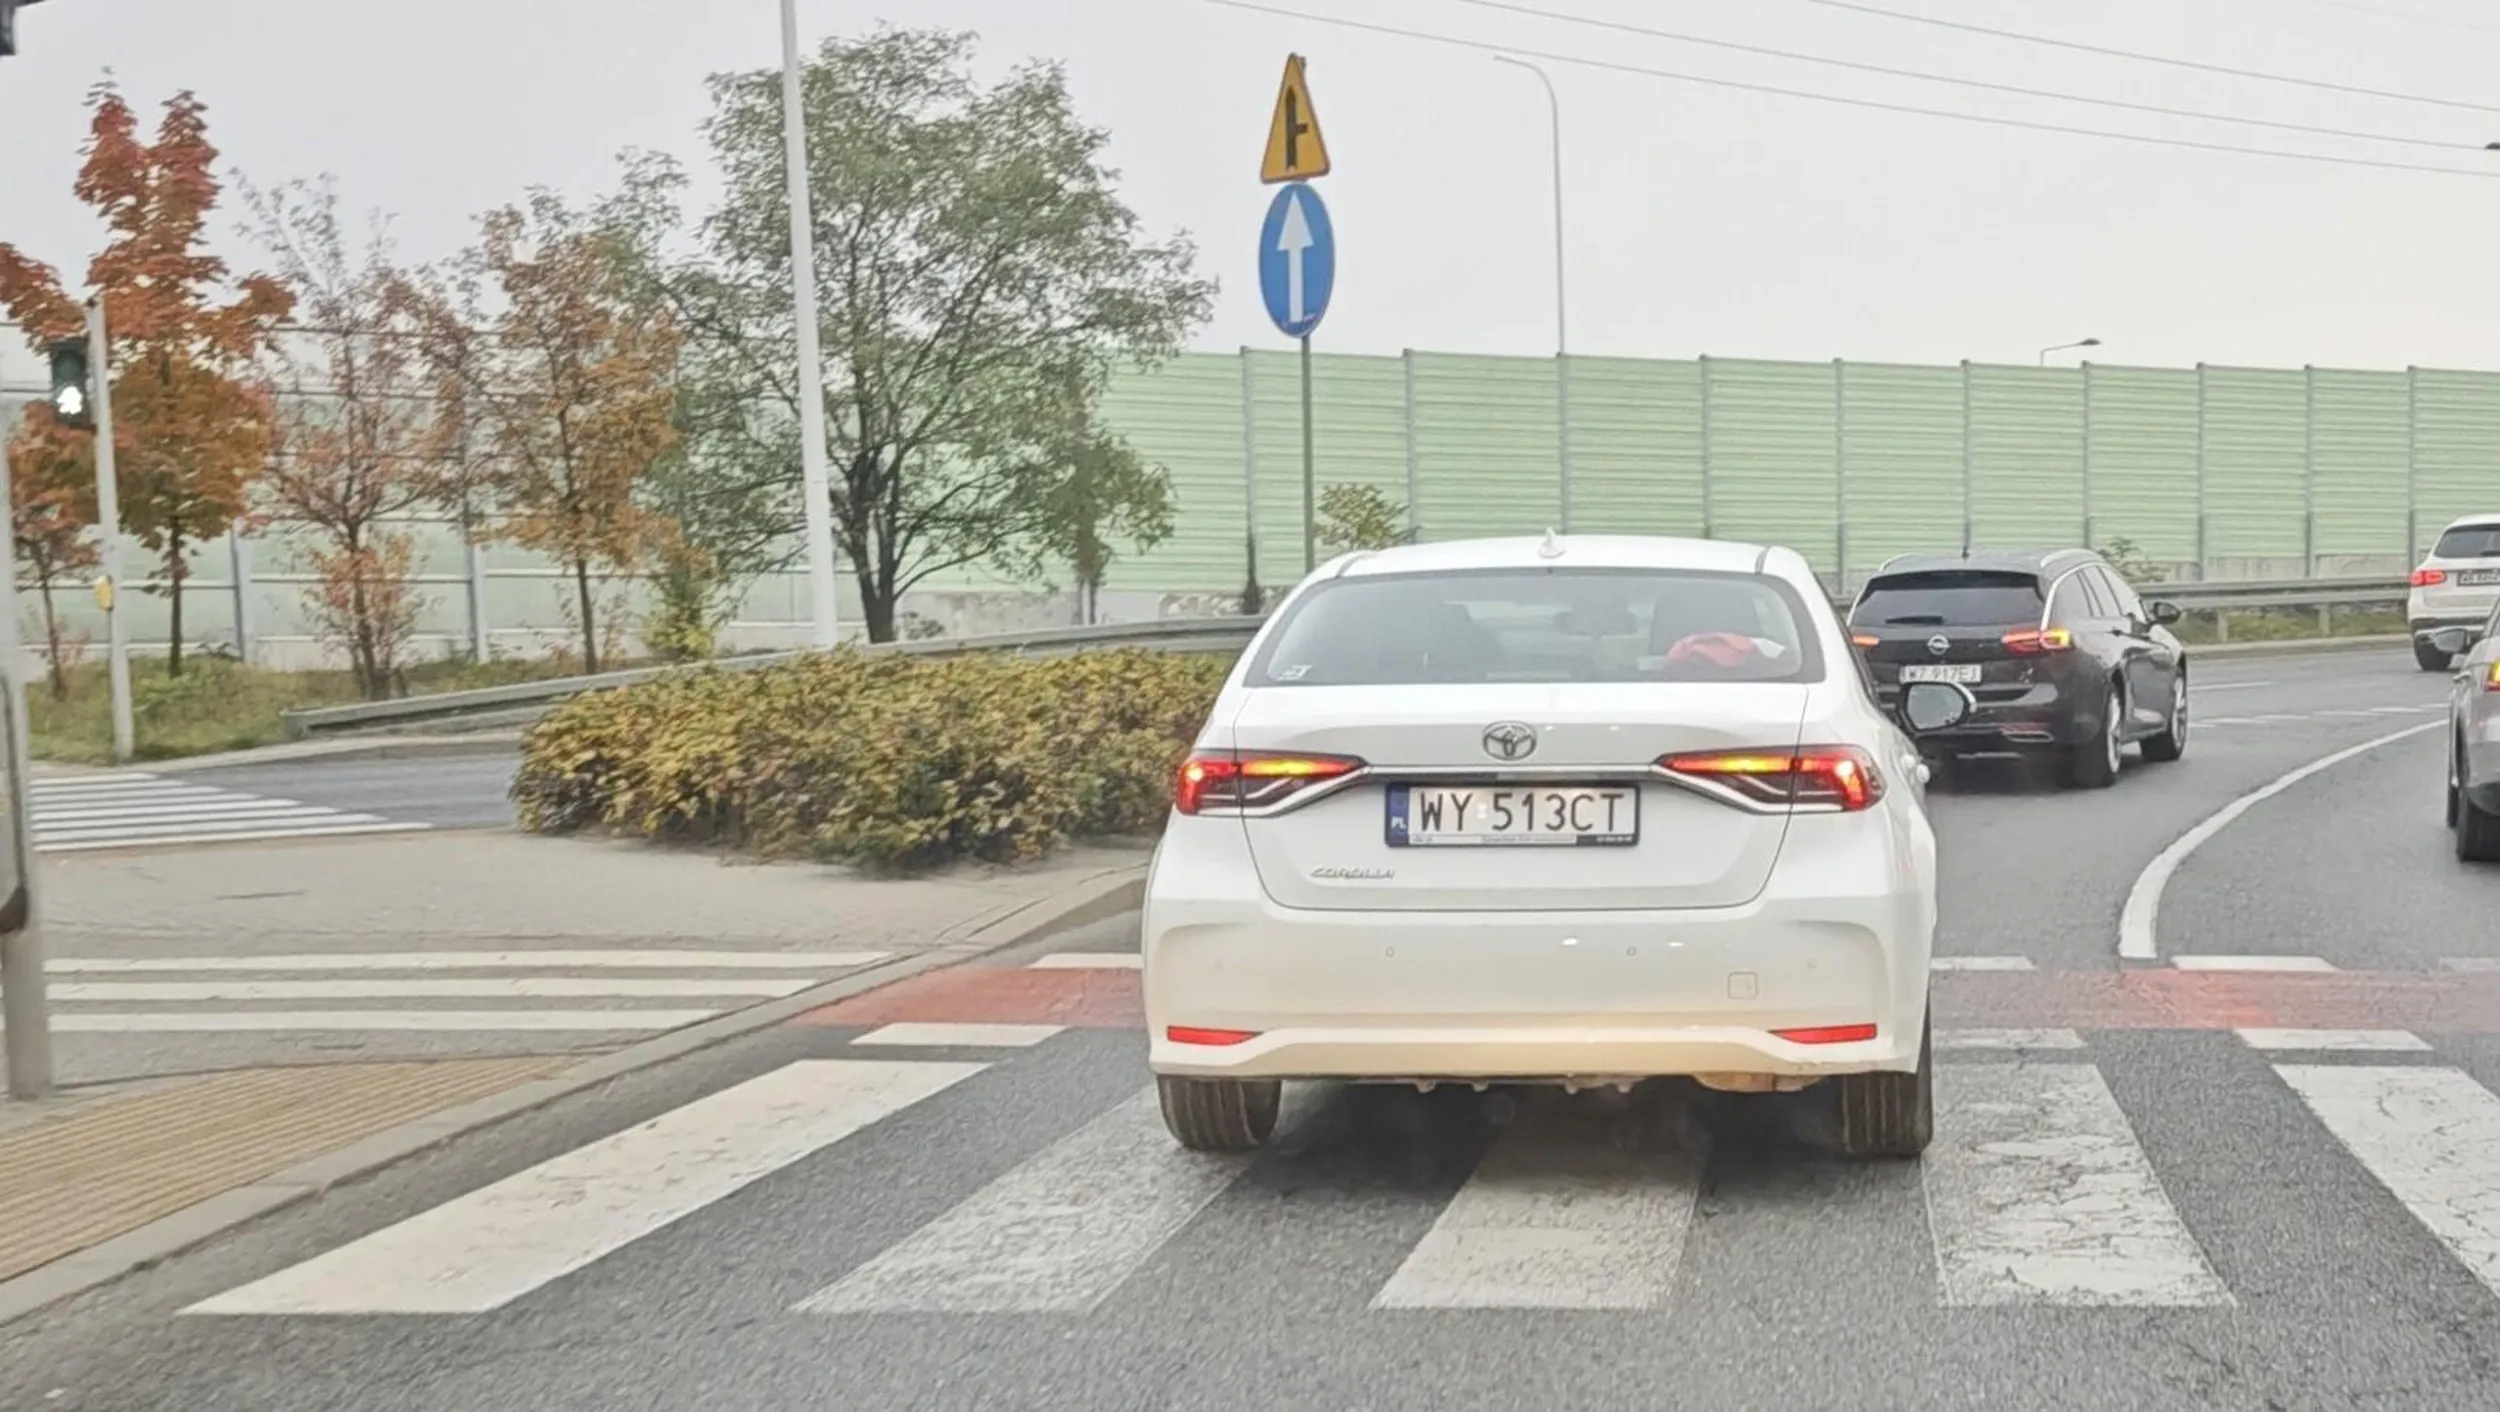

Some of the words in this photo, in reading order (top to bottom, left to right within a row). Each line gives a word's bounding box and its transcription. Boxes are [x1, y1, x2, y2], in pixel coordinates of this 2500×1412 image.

[1391, 815, 1407, 830] PL
[1419, 792, 1473, 832] WY
[1491, 792, 1624, 832] 513CT
